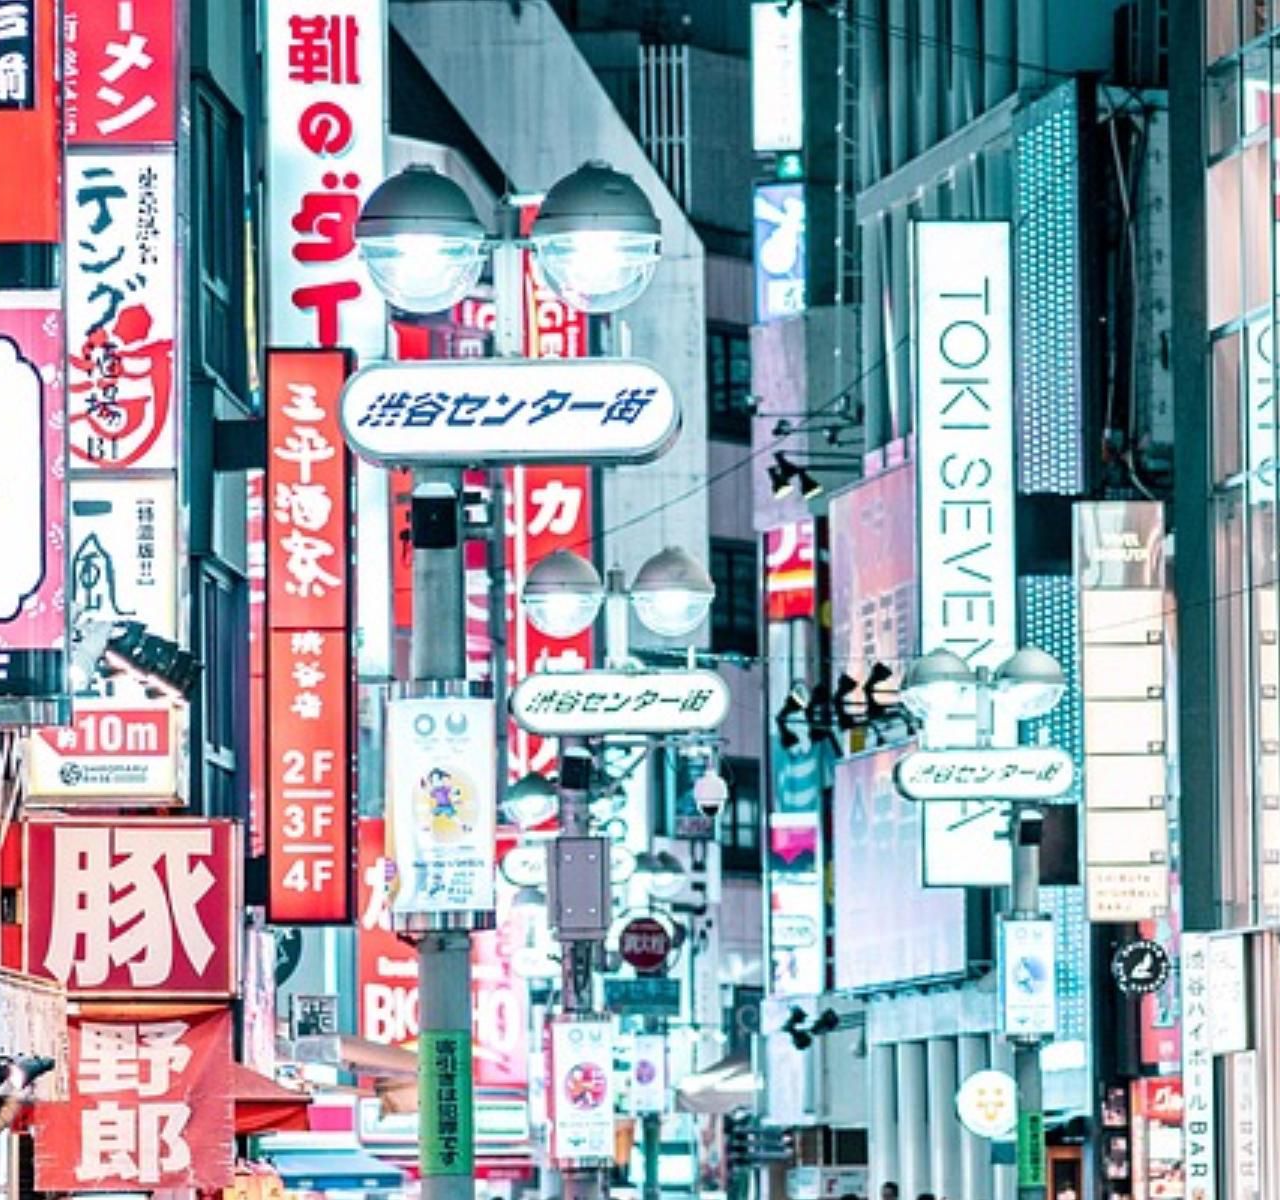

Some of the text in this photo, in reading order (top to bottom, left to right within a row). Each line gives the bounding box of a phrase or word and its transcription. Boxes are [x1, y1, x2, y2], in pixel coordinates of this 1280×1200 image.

[938, 276, 991, 430] TOKI
[356, 388, 658, 427] 渋谷センター街
[524, 689, 714, 714] 渋谷センター街
[282, 750, 334, 784] 2F
[282, 804, 334, 838] 3F
[282, 859, 334, 892] 4F
[43, 826, 217, 989] 豚
[75, 1021, 193, 1184] 野郎
